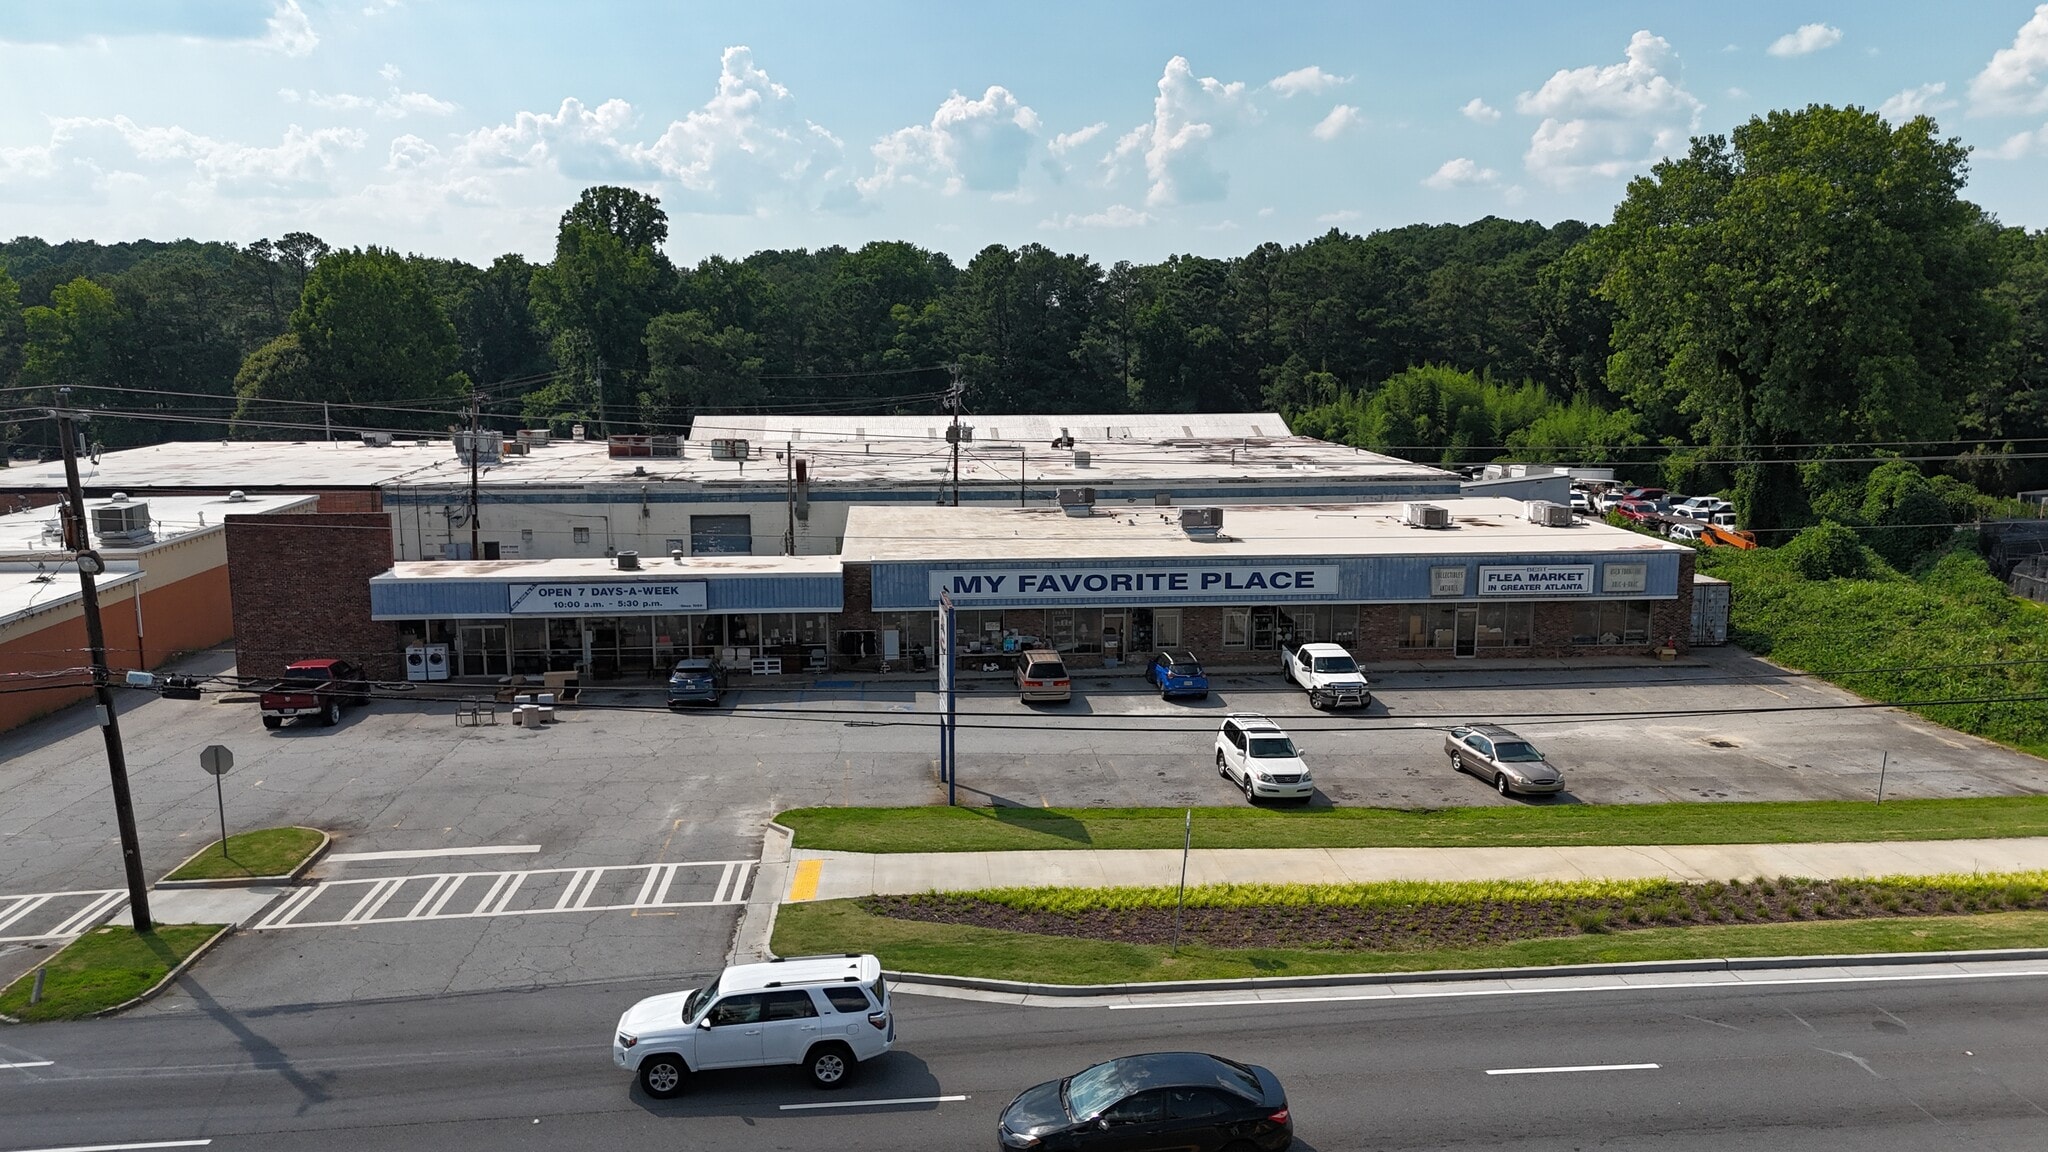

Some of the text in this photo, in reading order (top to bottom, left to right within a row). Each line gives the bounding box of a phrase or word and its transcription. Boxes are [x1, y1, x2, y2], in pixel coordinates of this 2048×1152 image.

[953, 571, 1315, 594] MY FAVORITE PLACE
[1488, 572, 1584, 582] FLEA MARKET
[538, 586, 679, 597] OPEN 7 DAYS-A-WEEK
